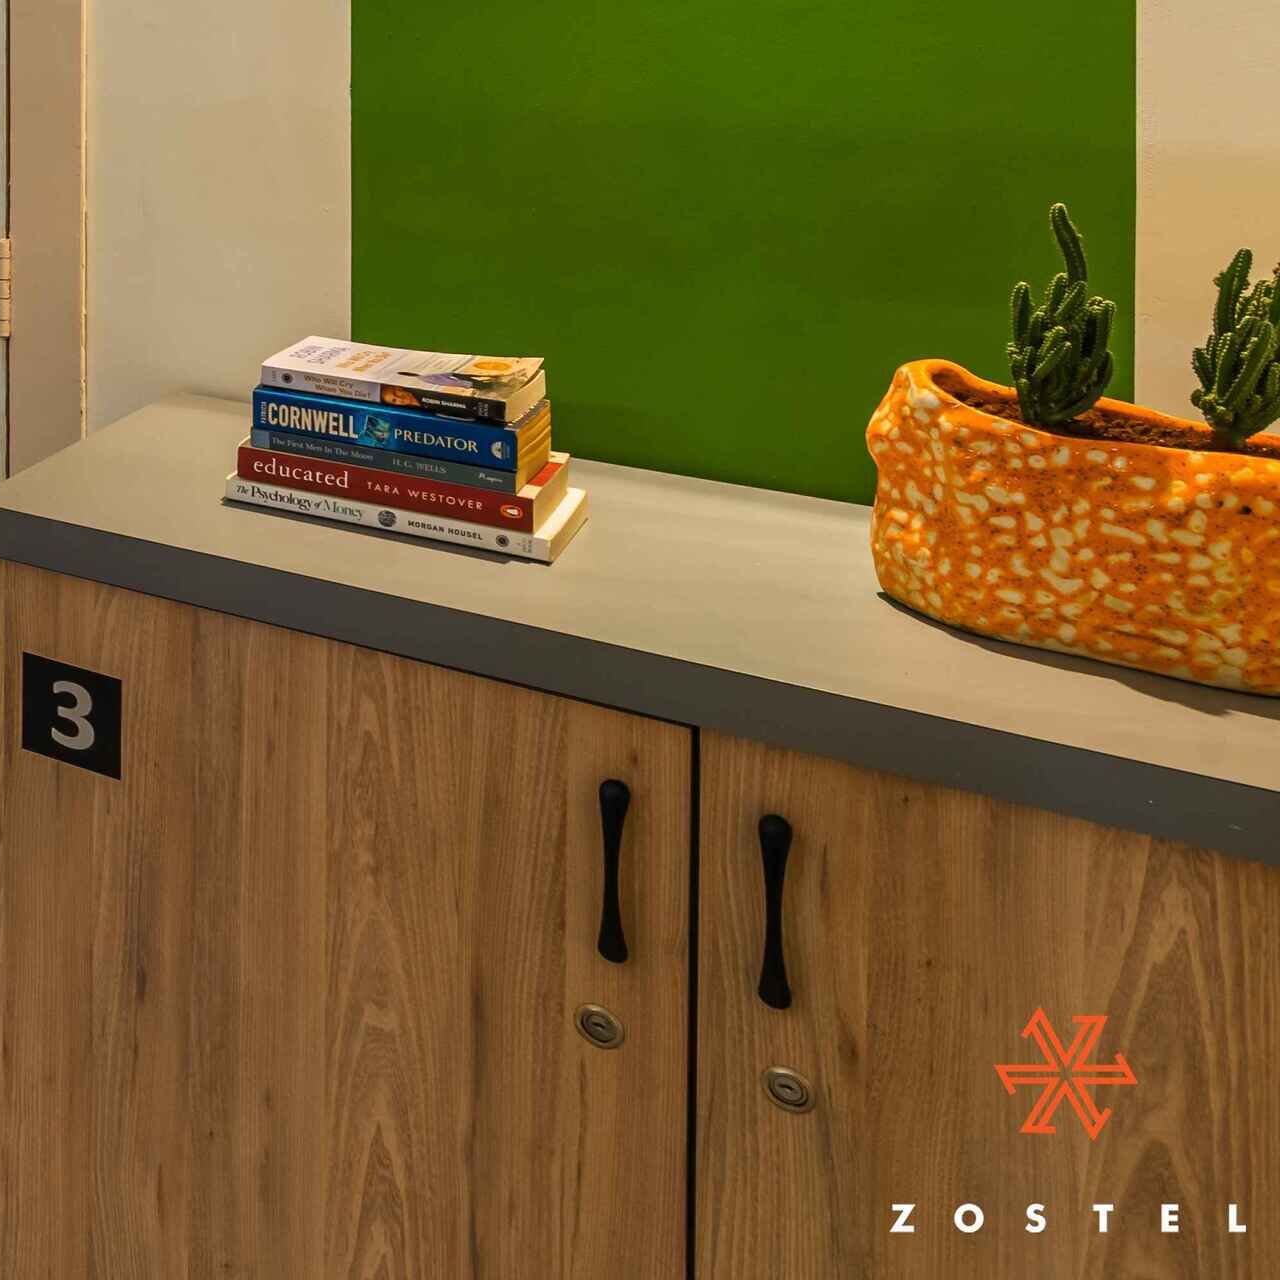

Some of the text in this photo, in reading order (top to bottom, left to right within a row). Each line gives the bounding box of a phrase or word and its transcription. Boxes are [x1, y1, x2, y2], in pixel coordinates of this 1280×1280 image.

[268, 402, 359, 439] CORNWELL
[271, 437, 286, 446] The
[287, 438, 304, 449] First
[306, 442, 323, 451] Men
[394, 428, 479, 454] PREDATOR
[253, 458, 349, 489] educated
[236, 484, 249, 494] The
[251, 485, 313, 511] Psychology
[314, 500, 323, 508] of
[324, 499, 363, 520] Money
[367, 481, 483, 511] TARA WESTOVER
[408, 520, 483, 541] MORGAN HOUSEL
[51, 680, 95, 751] 3
